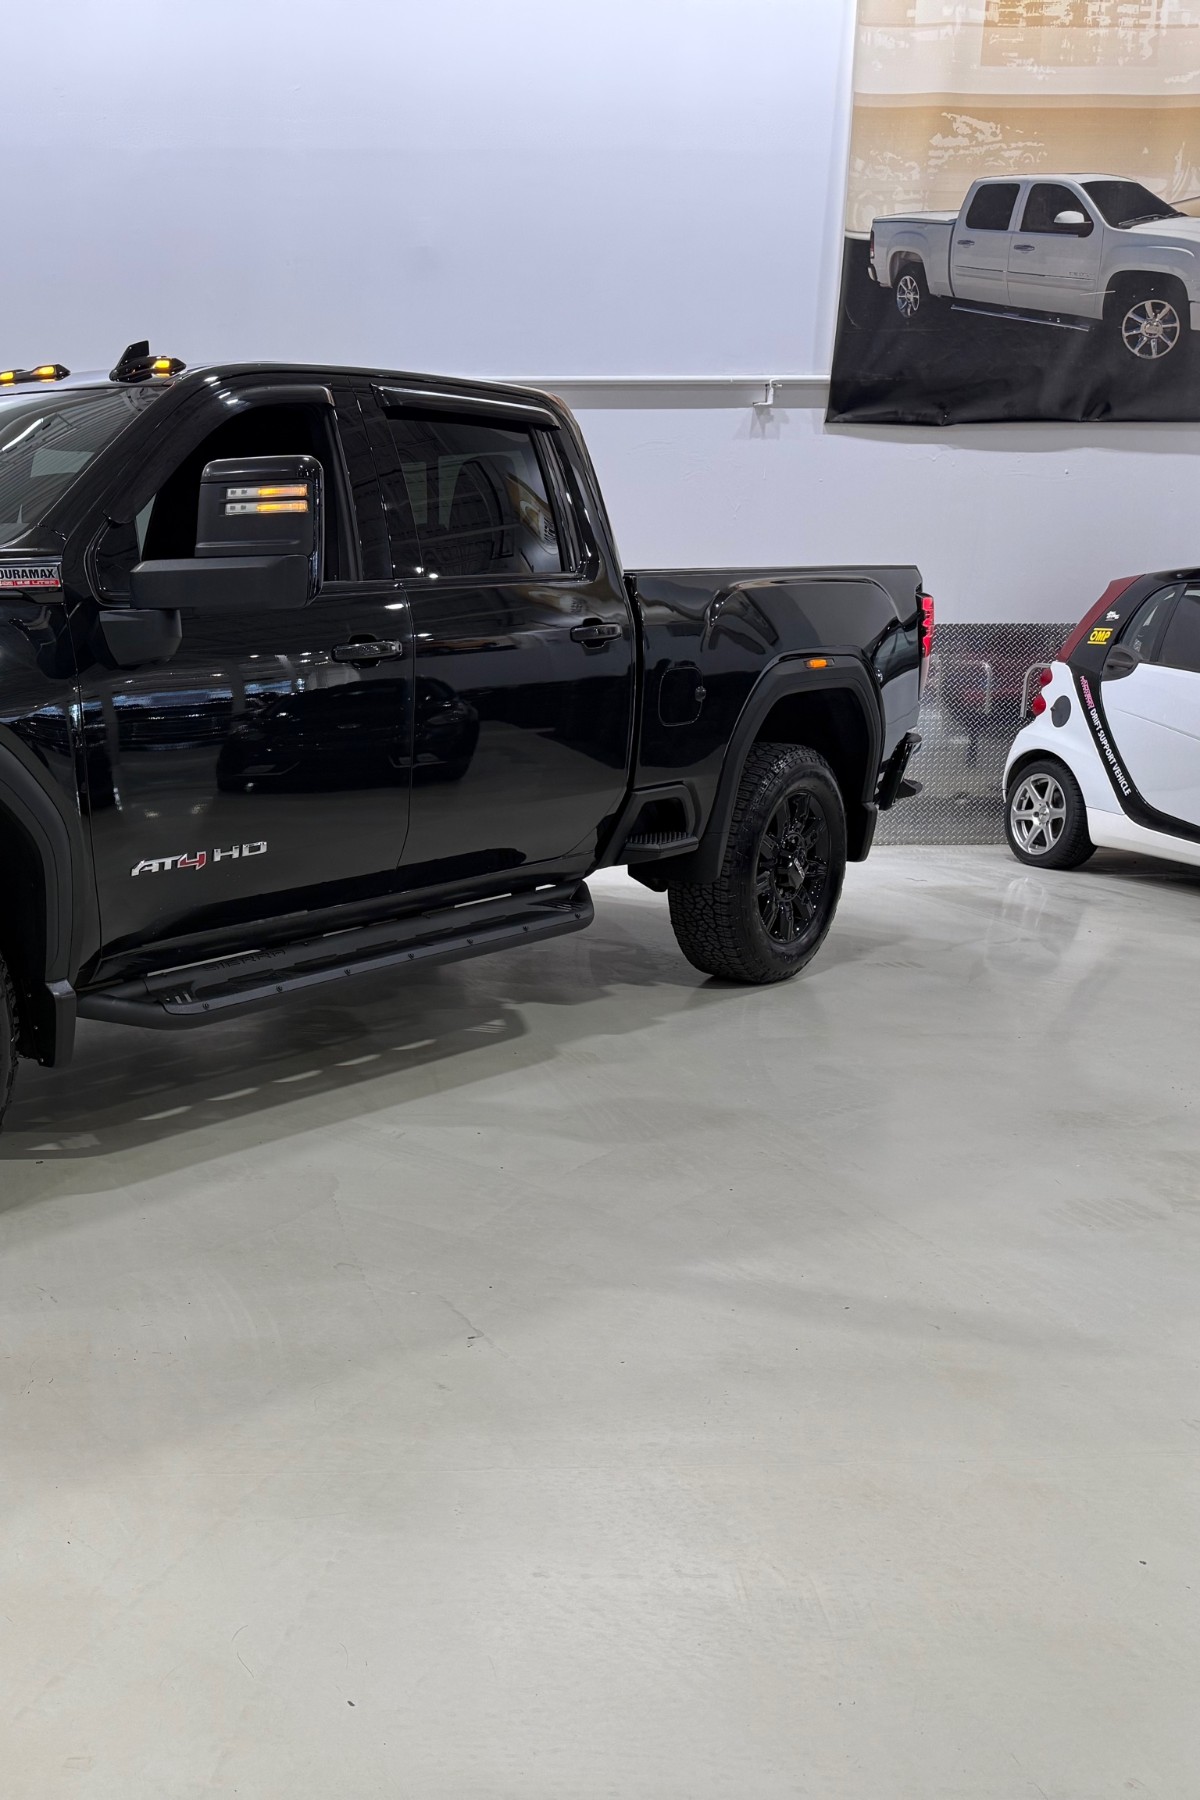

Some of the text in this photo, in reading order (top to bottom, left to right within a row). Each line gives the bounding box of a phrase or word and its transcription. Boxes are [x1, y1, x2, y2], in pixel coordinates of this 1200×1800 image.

[1089, 630, 1111, 642] OMP
[1090, 707, 1132, 797] DRIFT SUPPORT VEHICLE
[130, 841, 268, 877] AT4 HD
